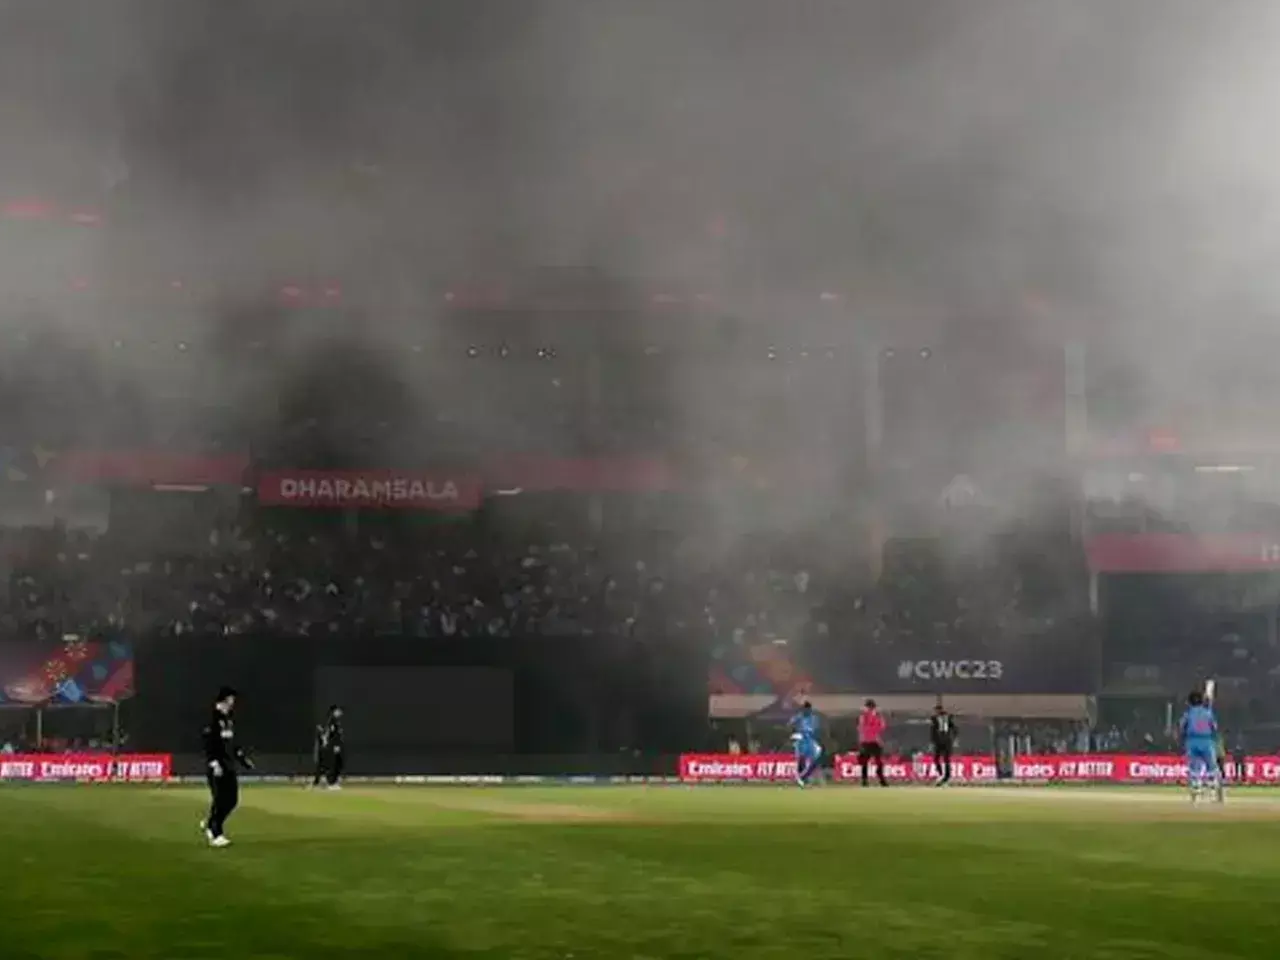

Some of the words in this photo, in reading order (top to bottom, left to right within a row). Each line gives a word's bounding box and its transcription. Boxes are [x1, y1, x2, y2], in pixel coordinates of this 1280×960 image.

[280, 478, 459, 500] DHARAMSALA
[898, 660, 1003, 679] #CWC23
[41, 761, 103, 777] Emirates
[688, 761, 752, 777] Emirates
